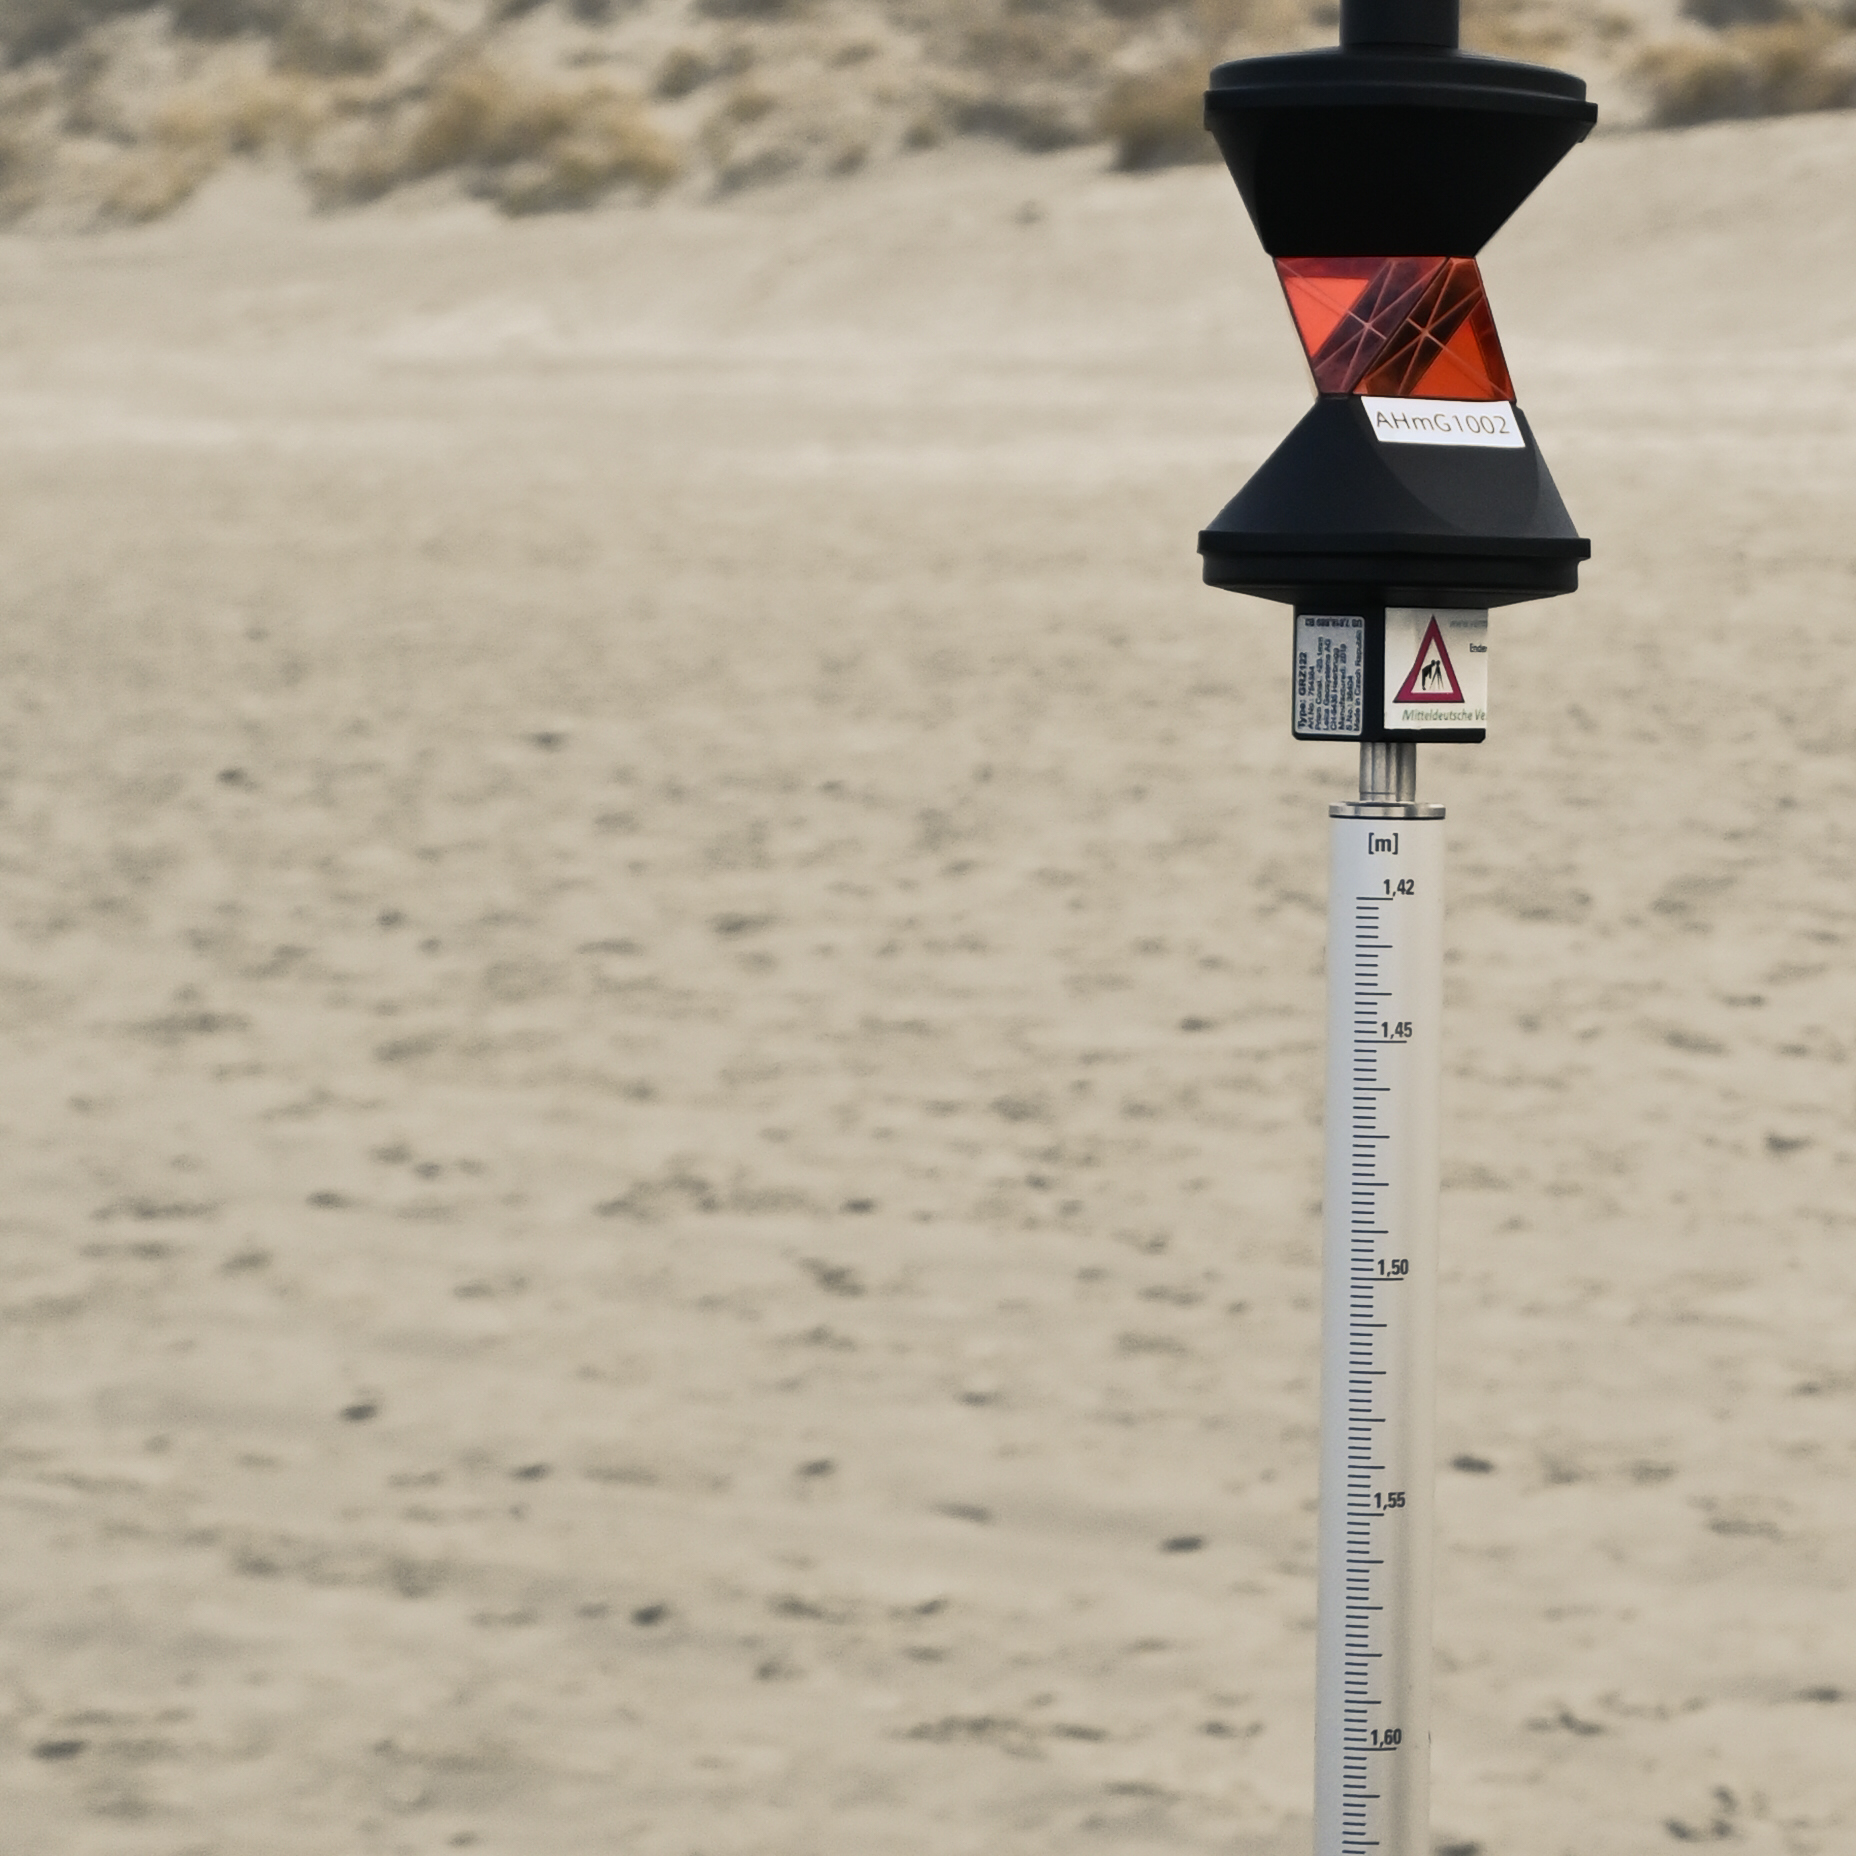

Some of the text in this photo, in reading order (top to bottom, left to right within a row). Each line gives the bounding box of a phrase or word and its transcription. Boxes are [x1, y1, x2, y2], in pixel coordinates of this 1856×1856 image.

[1376, 410, 1511, 435] AHmG1002
[1469, 643, 1487, 653] Ende
[1298, 651, 1307, 697] GRZ122
[1401, 709, 1486, 722] Mitteldeutsche Ve
[1368, 831, 1399, 855] [m]
[1382, 878, 1415, 897] 1,42
[1380, 1021, 1413, 1040] 1,45
[1377, 1258, 1410, 1278] 1,50
[1373, 1491, 1407, 1511] 1,55
[1369, 1728, 1403, 1748] 1,60
